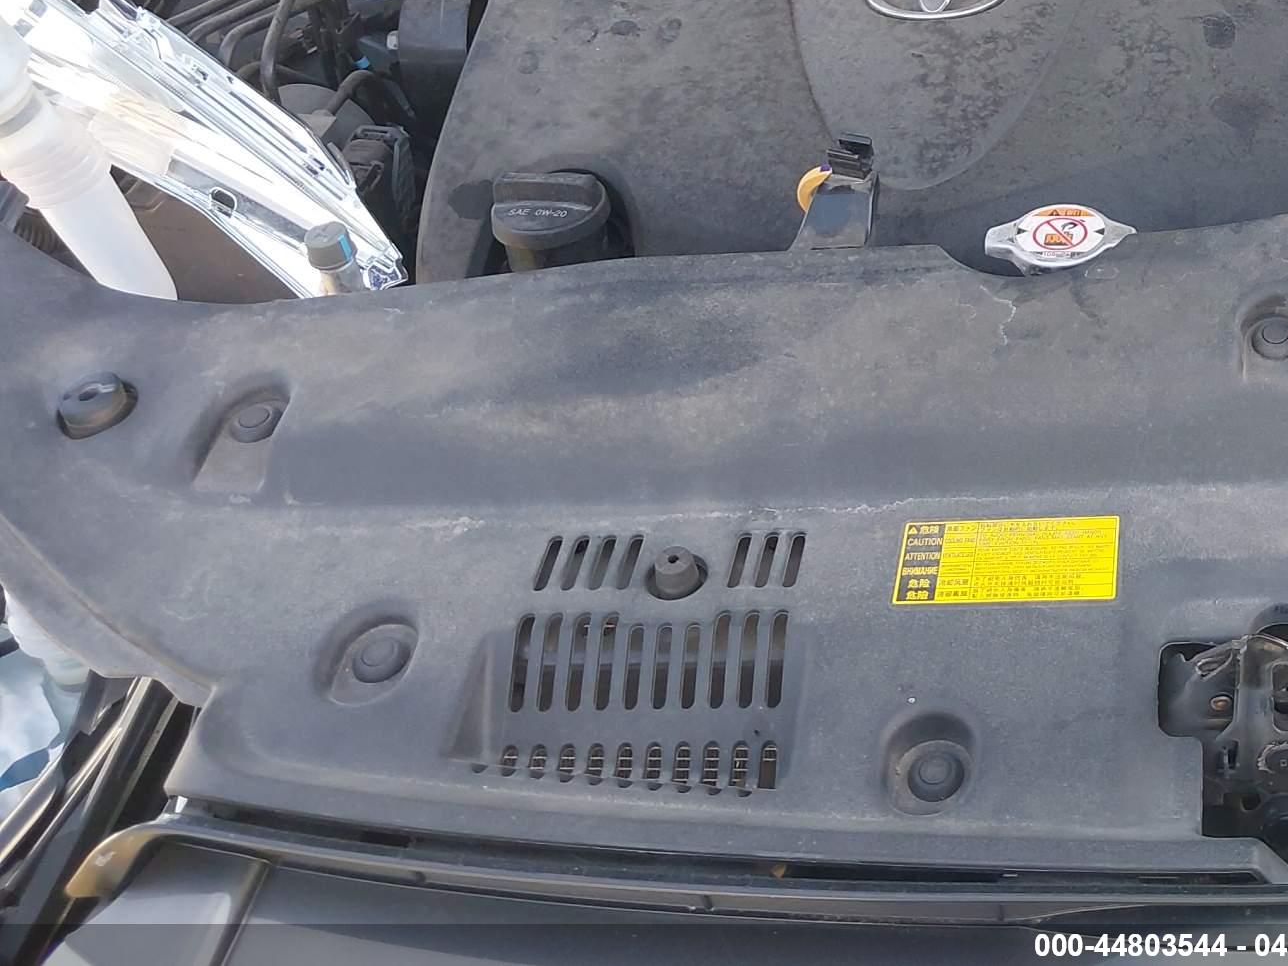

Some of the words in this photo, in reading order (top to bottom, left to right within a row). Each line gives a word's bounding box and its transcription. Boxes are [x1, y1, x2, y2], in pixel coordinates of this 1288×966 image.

[508, 208, 532, 217] SAE
[535, 209, 568, 218] 0W-20
[907, 537, 943, 546] CAUTION
[904, 552, 941, 561] ATTENTION
